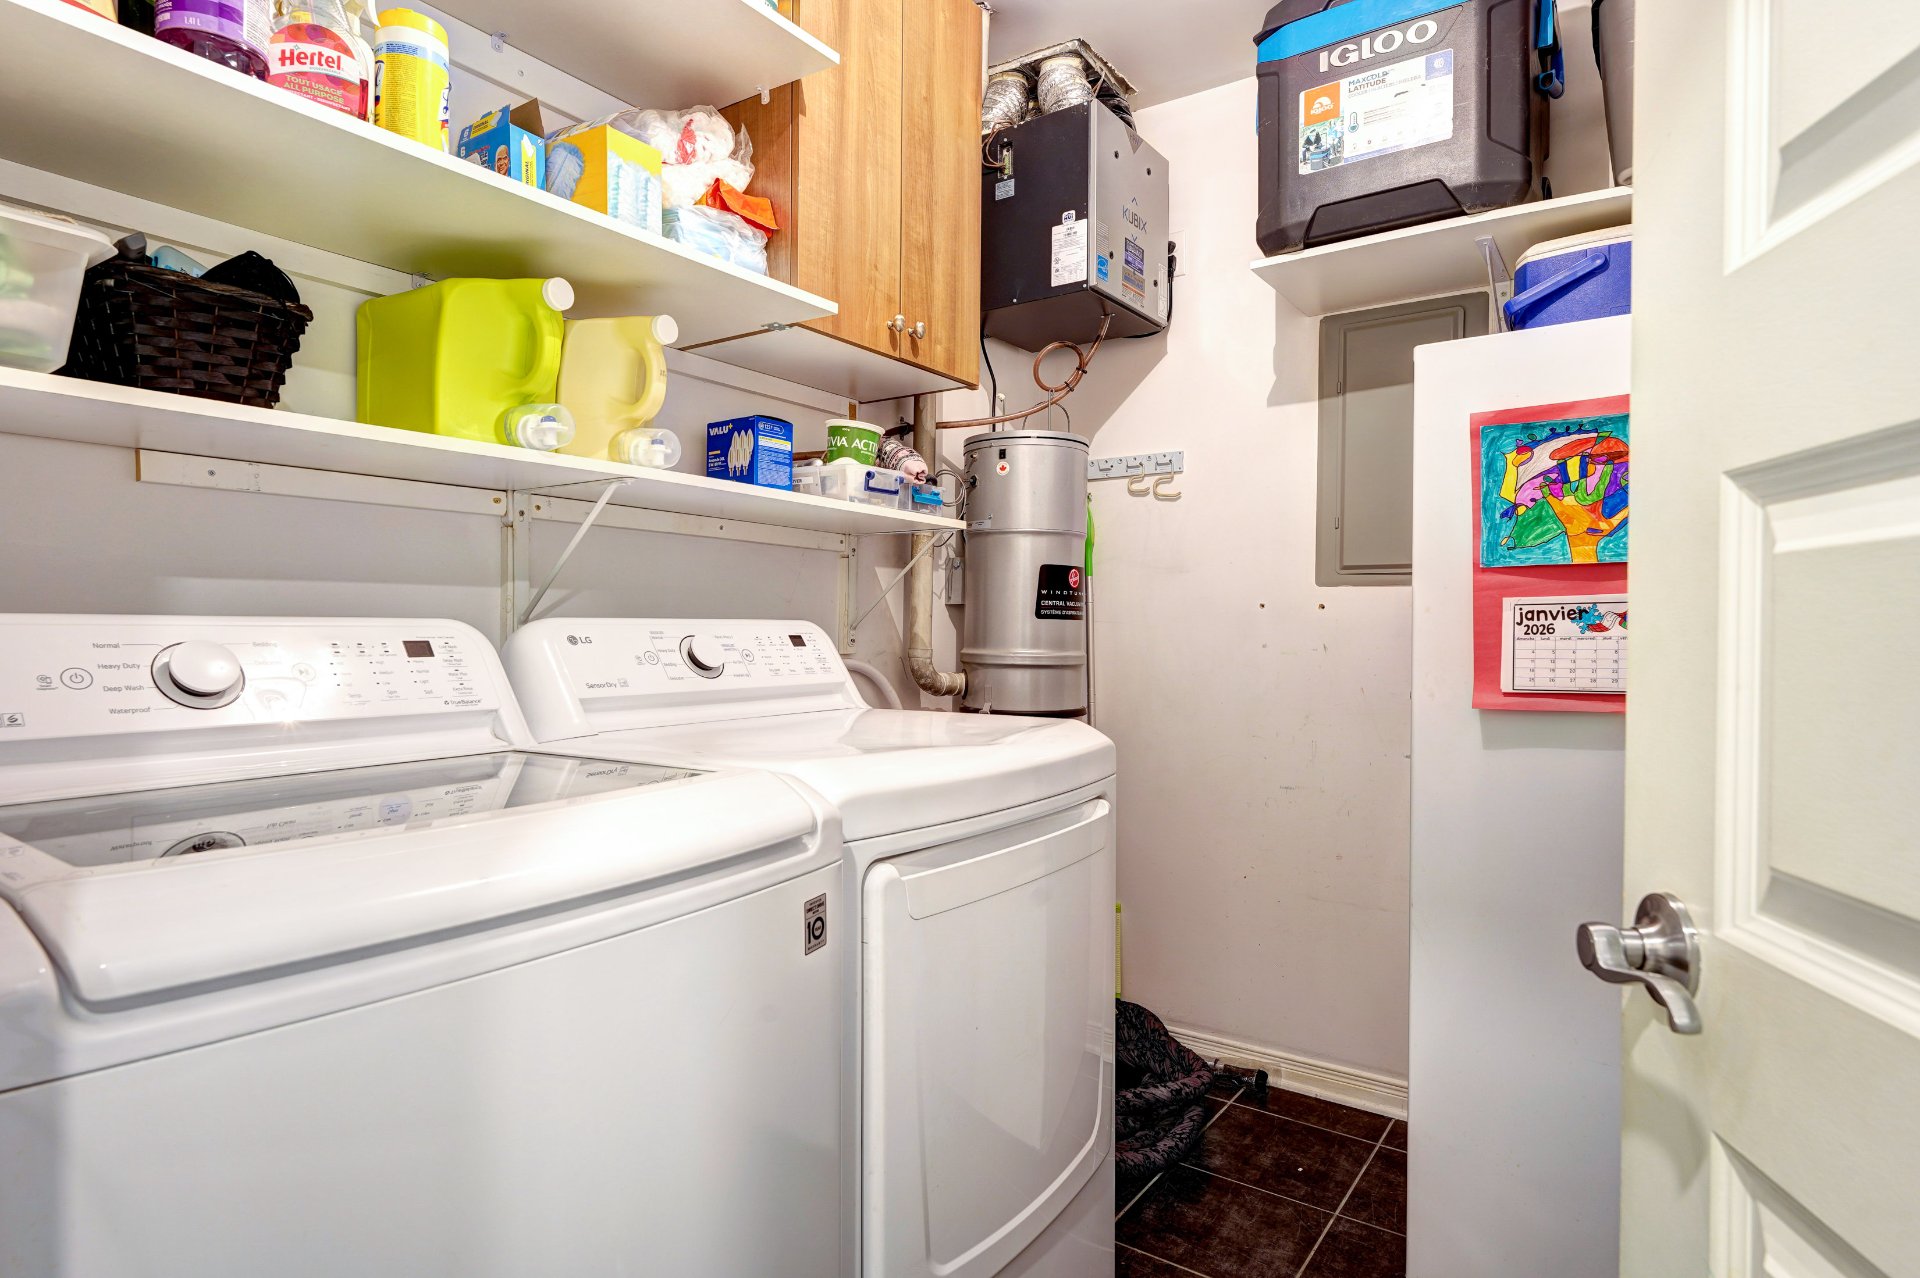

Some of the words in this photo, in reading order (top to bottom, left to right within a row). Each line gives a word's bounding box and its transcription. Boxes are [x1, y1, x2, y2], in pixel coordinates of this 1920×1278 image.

[1319, 19, 1438, 73] IGLOO
[278, 48, 342, 71] Hertel
[283, 82, 299, 91] ALL
[301, 86, 345, 104] PURPOSE
[286, 75, 312, 86] TOUT
[312, 82, 344, 96] USAGE
[1349, 78, 1387, 94] LATITUDE
[1122, 205, 1148, 234] KUBIX
[1516, 606, 1590, 626] janvier
[1523, 623, 1556, 636] 2026
[92, 642, 121, 650] Normal
[579, 636, 593, 644] LG
[97, 662, 121, 671] Heavy
[122, 662, 141, 670] Duty
[103, 684, 123, 693] Deep
[125, 684, 145, 692] Wash
[585, 681, 617, 689] SensorDry
[108, 706, 151, 715] Waterproof
[807, 916, 825, 944] 10
